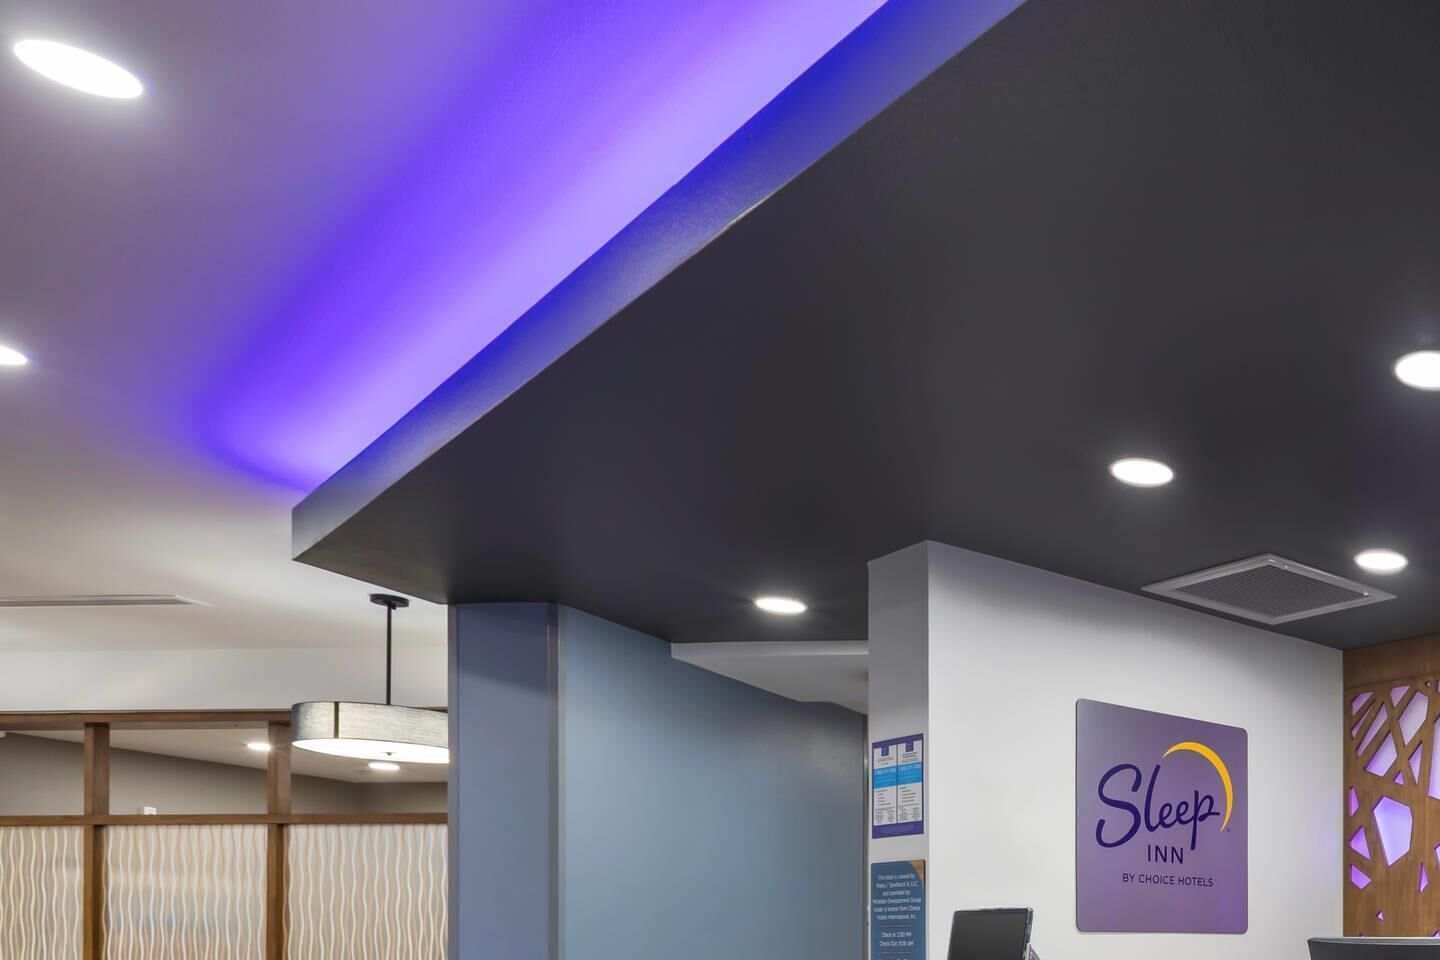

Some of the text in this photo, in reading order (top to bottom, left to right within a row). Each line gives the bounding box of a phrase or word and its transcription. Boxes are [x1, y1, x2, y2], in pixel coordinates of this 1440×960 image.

[1096, 763, 1220, 850] Sleep
[1147, 844, 1184, 864] INN
[1122, 873, 1214, 887] BY CHOICE HOTELS
